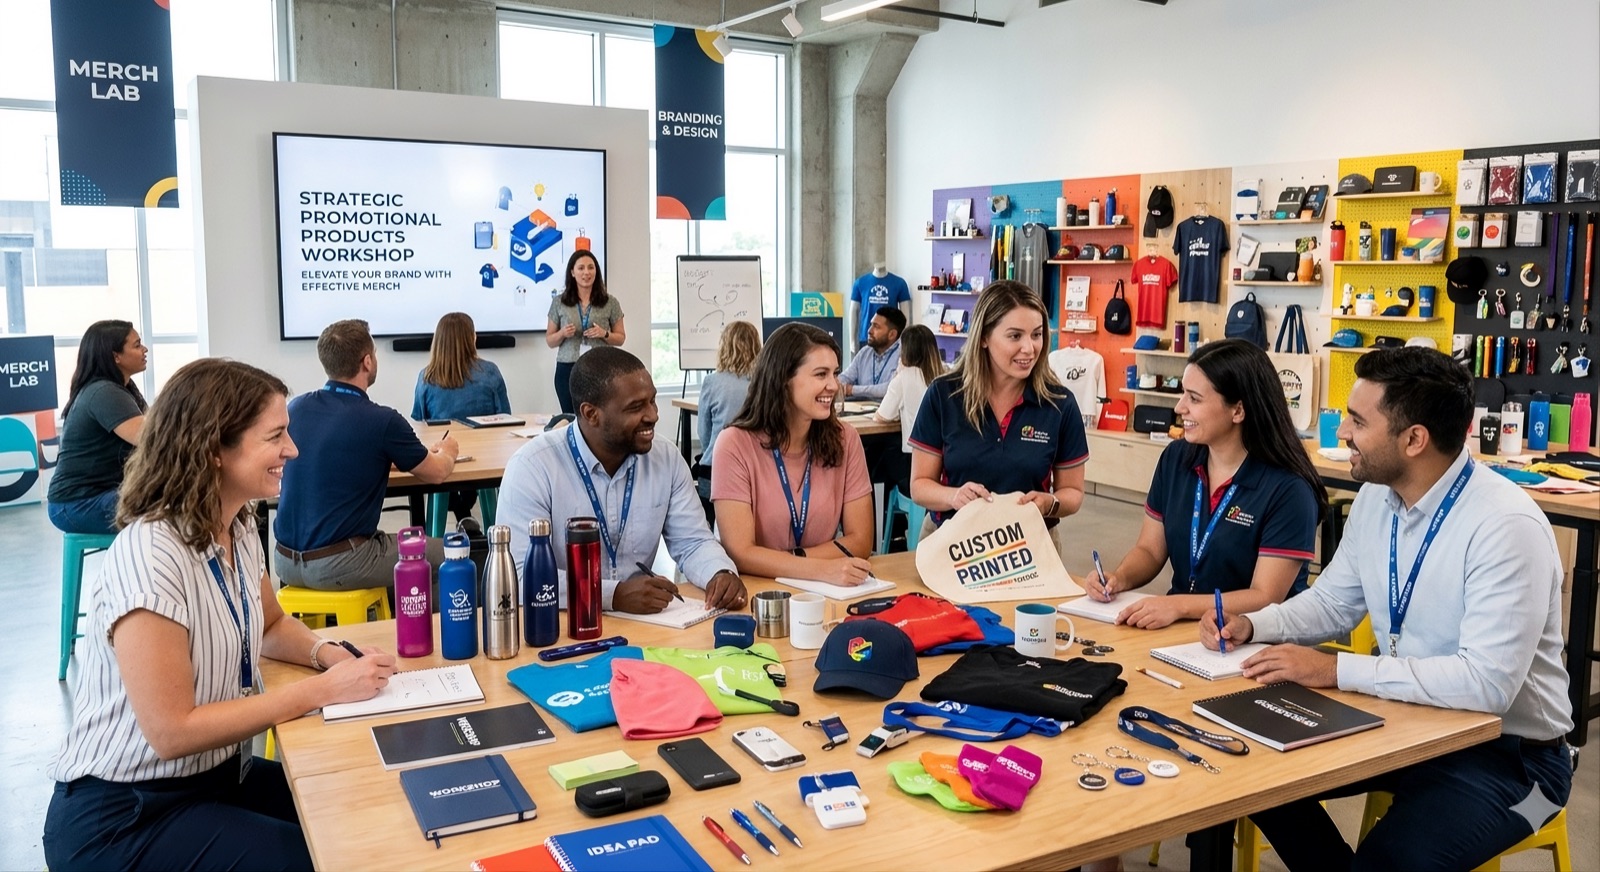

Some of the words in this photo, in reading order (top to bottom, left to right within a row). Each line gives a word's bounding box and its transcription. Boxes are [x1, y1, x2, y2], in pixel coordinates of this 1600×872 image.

[69, 59, 159, 83] MERCH
[91, 82, 141, 102] LAB
[658, 110, 722, 125] BRANDING
[662, 125, 671, 136] &
[674, 125, 718, 138] DESIGN
[299, 191, 404, 206] STRATEGIC
[300, 211, 442, 226] PROMOTIONAL
[301, 229, 405, 243] PRODUCTS
[301, 248, 414, 262] WORKSHOP
[301, 270, 349, 279] ELEVATE
[351, 270, 382, 279] YOUR
[384, 270, 422, 279] BRAND
[424, 270, 452, 279] WITH
[301, 282, 360, 291] EFFECTIVE
[362, 282, 401, 291] MERCH
[0, 361, 49, 374] MERCH
[9, 375, 39, 387] LAB
[948, 522, 1025, 562] CUSTOM
[956, 547, 1033, 585] PRINTED
[587, 843, 625, 856] IDEA
[627, 835, 660, 849] PAD
